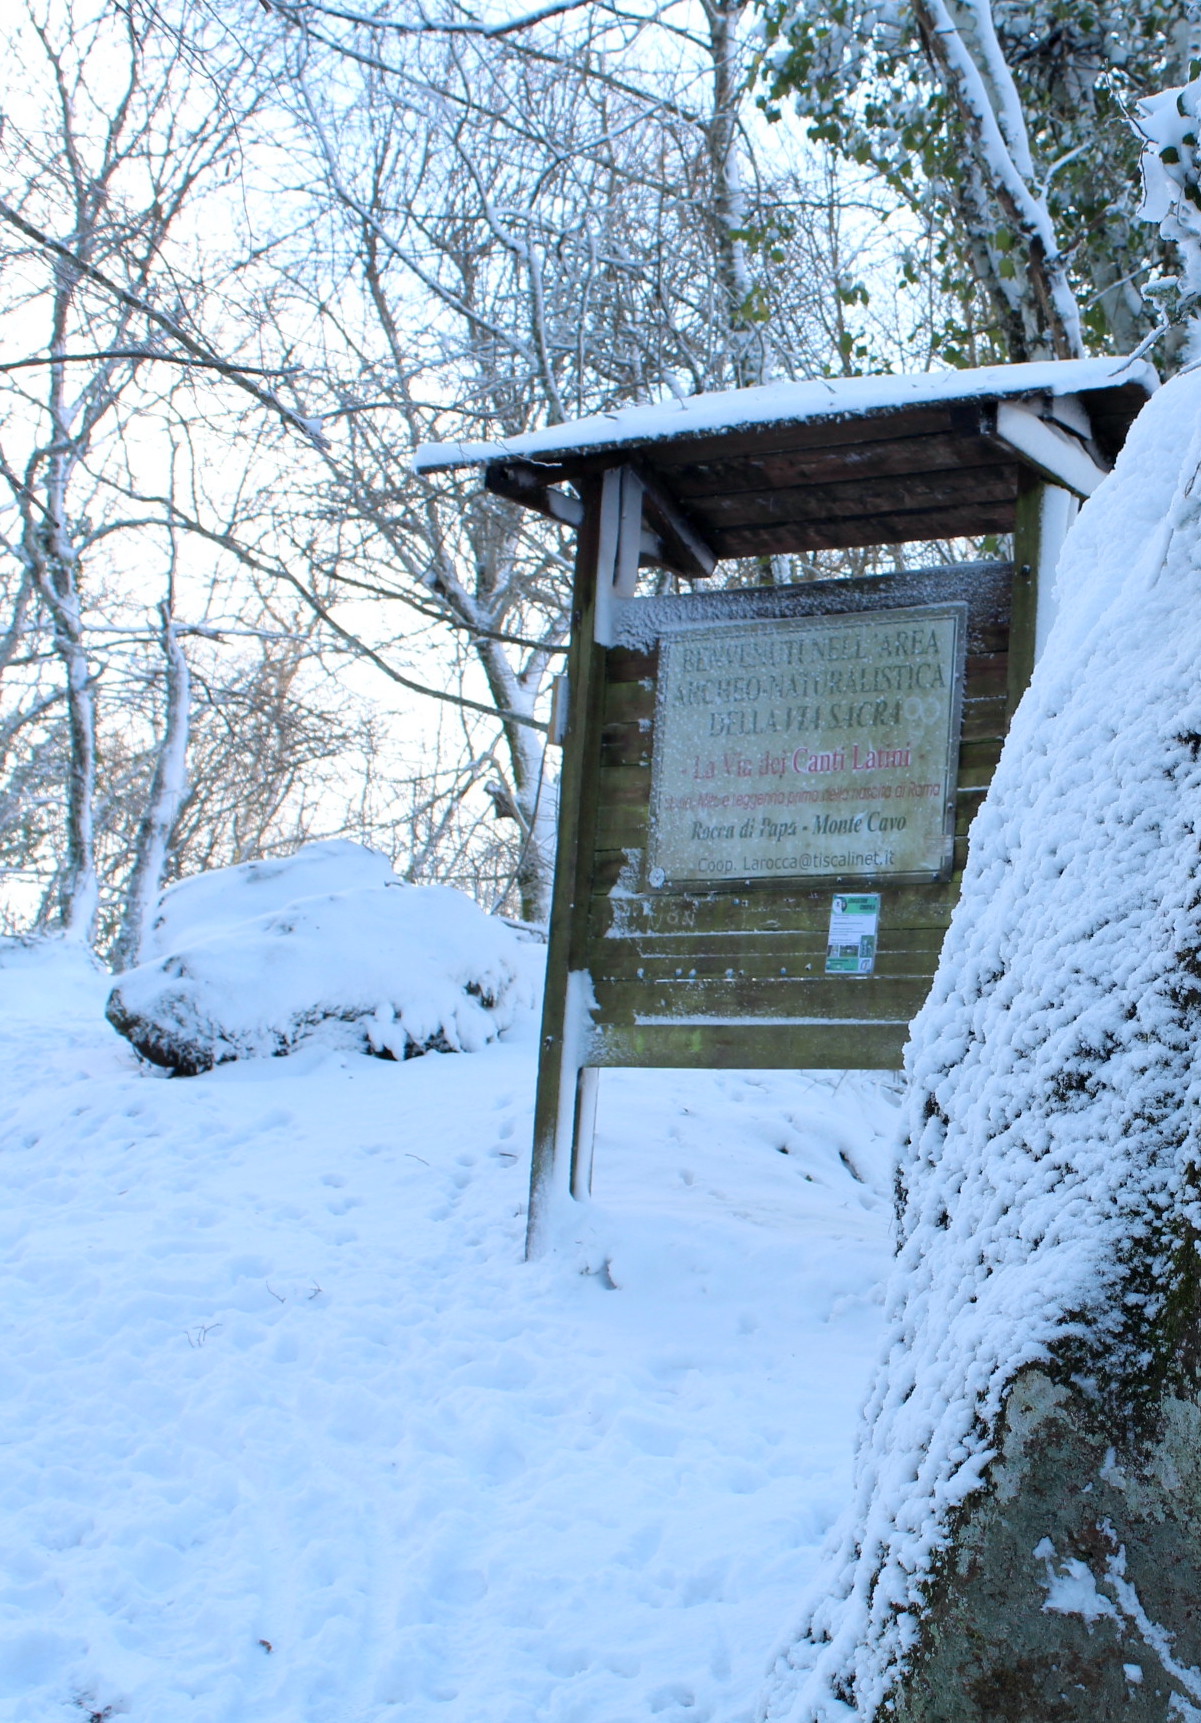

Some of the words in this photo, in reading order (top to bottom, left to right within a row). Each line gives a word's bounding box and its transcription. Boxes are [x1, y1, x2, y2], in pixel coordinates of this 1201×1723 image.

[682, 639, 805, 673] BENVENUTI
[672, 662, 945, 707] ARCHEO-NATURALISTICA
[709, 708, 777, 737] DELLA
[783, 704, 820, 732] VIA
[827, 699, 902, 730] SACRA
[692, 755, 716, 779] La
[722, 751, 753, 777] Via
[758, 749, 787, 777] dei
[792, 745, 845, 774] Canti
[852, 743, 912, 771] Latini
[908, 779, 941, 798] Roma
[690, 820, 735, 840] Rocca
[740, 817, 754, 839] di
[758, 817, 797, 842] Papa
[812, 813, 863, 836] Monte
[867, 811, 907, 833] Cavo
[697, 857, 737, 874] Coop.
[743, 849, 896, 871] Larocca@tiscalinet.it
